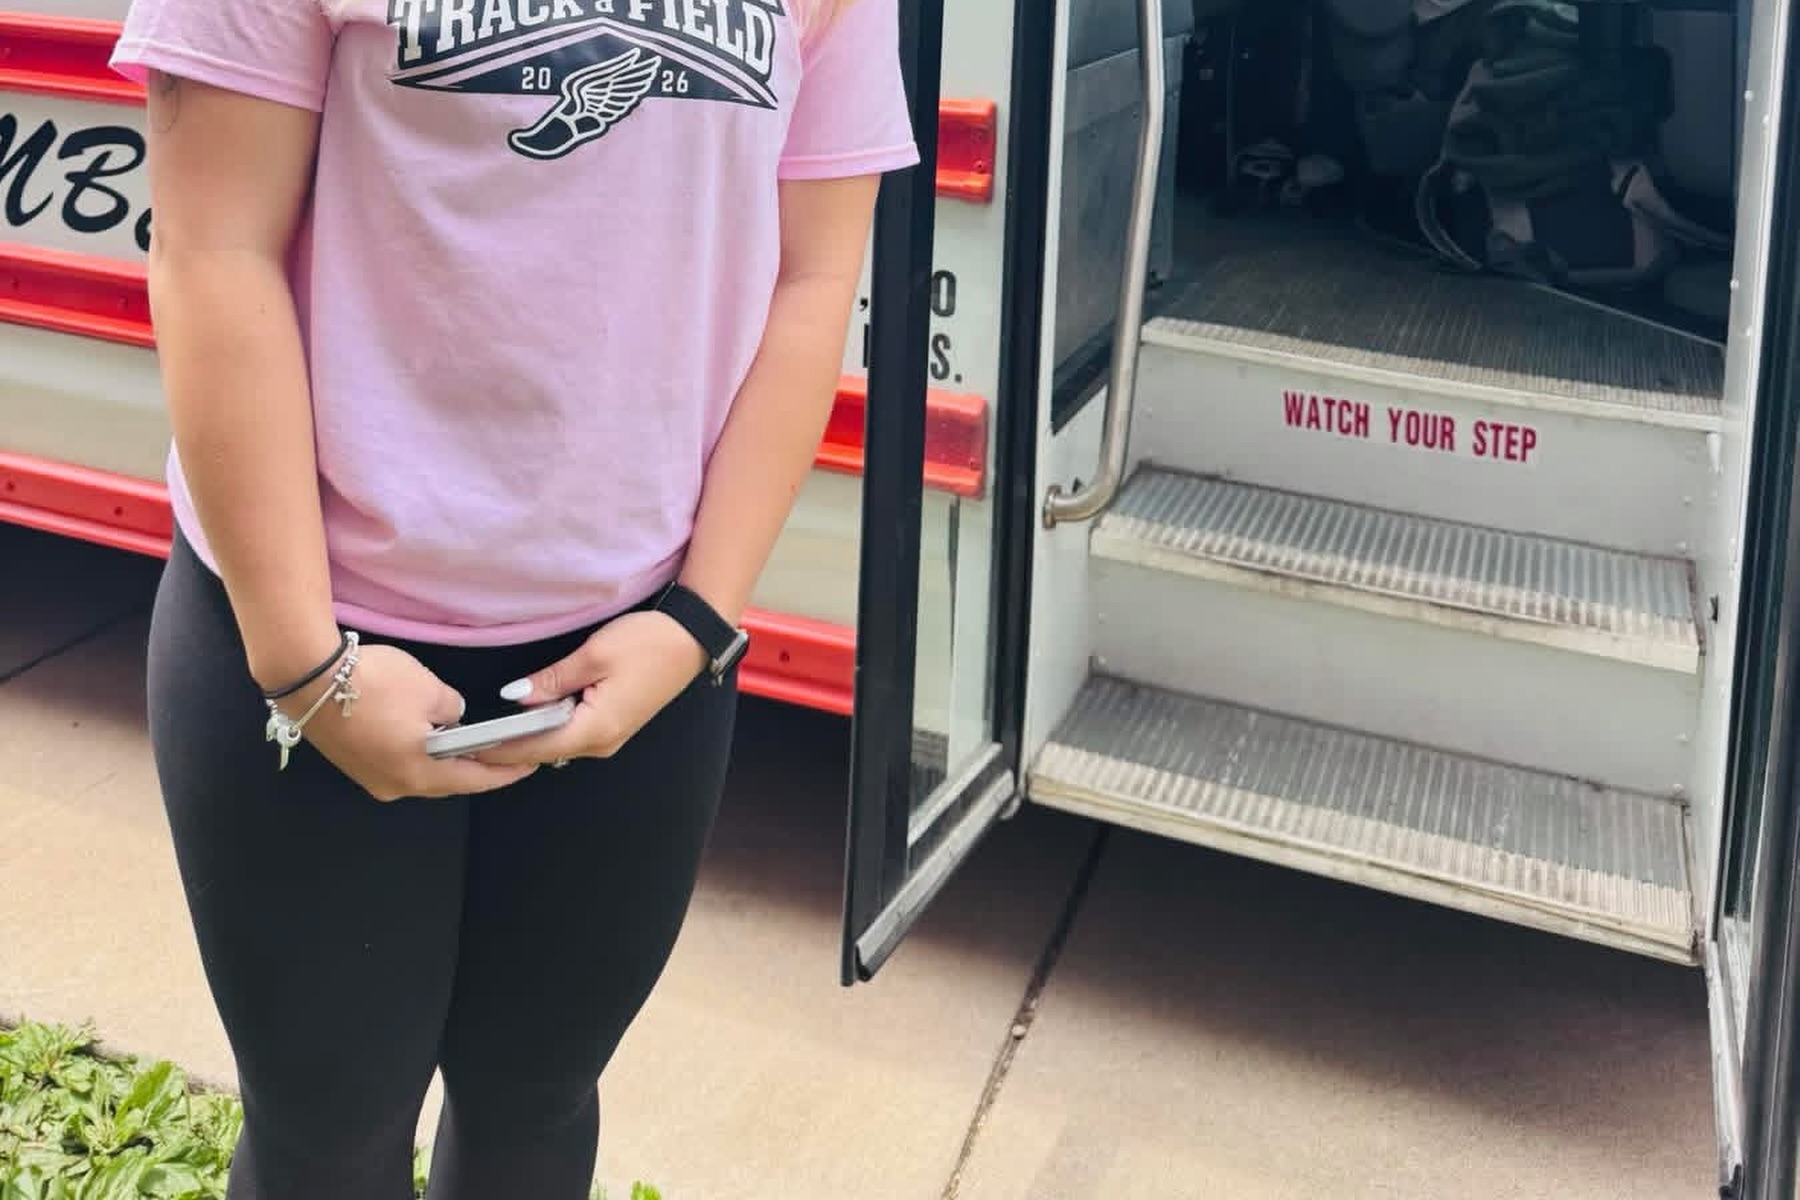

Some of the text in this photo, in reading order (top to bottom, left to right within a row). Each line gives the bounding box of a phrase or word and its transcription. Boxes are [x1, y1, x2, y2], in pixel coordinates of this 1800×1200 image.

[1283, 390, 1537, 462] WATCH YOUR STEP
